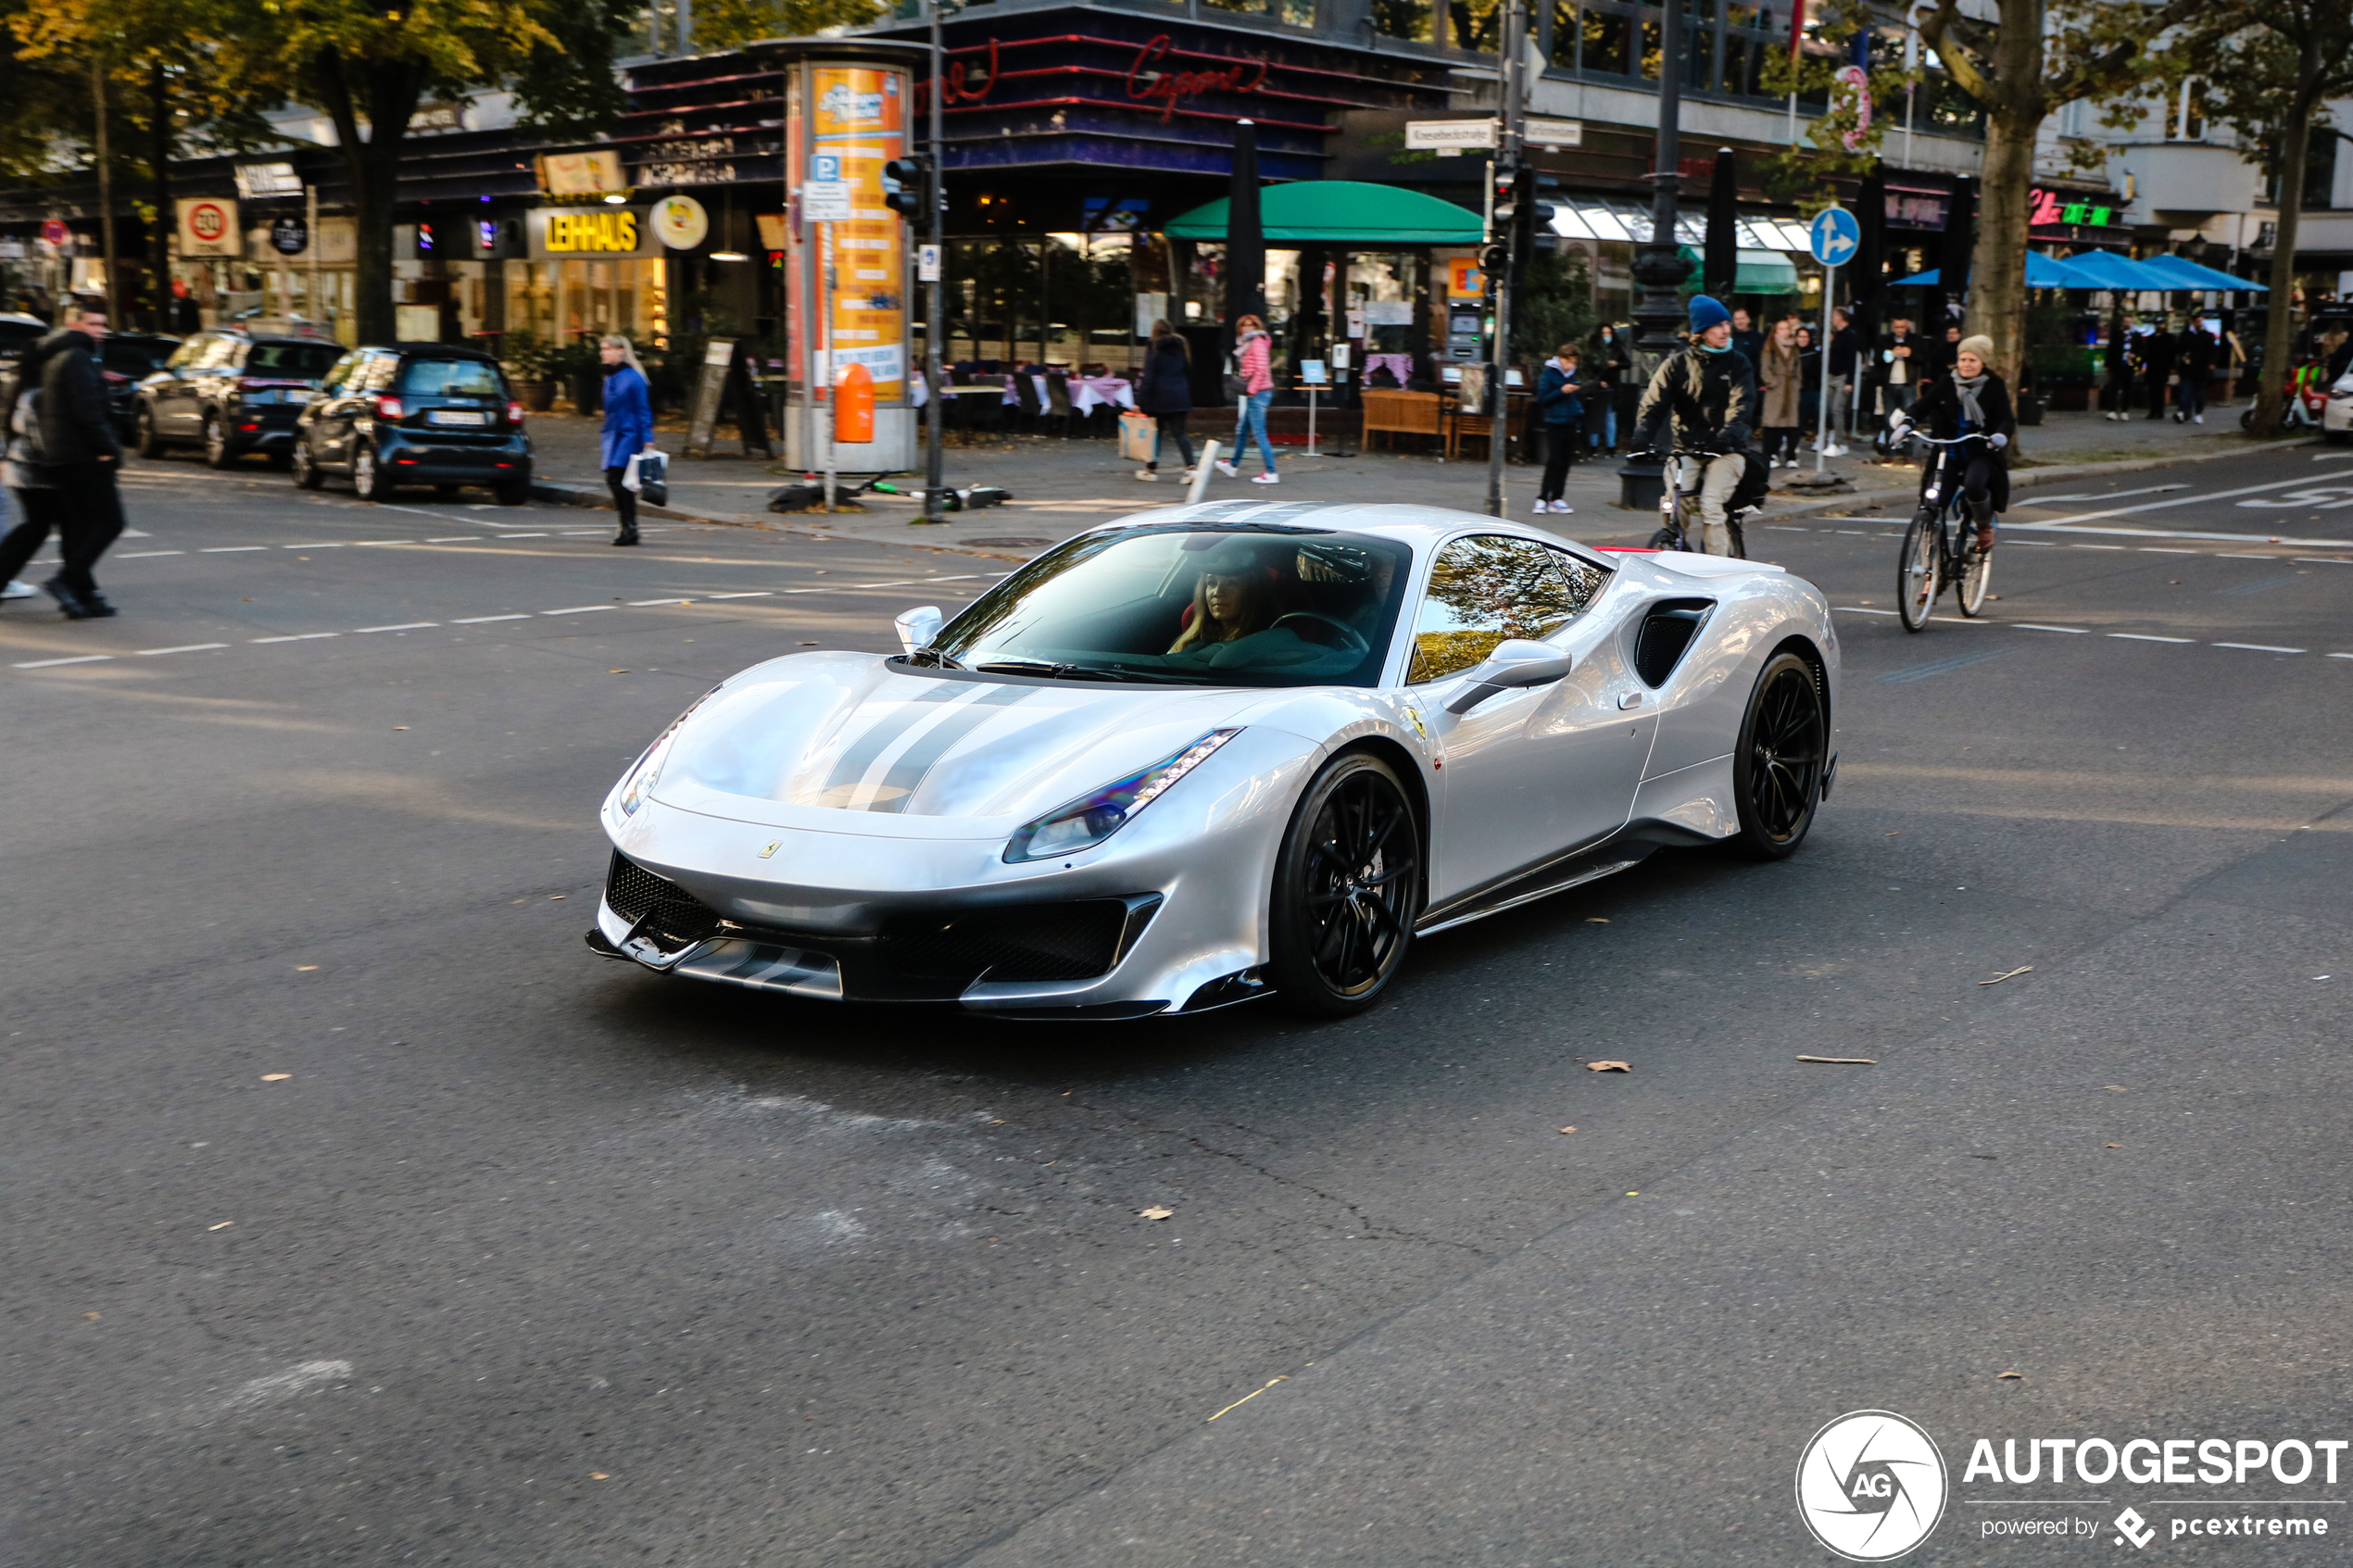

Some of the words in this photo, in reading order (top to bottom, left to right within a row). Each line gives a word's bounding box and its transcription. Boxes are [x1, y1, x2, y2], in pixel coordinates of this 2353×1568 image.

[1126, 34, 1269, 124] Capone
[195, 212, 220, 231] 30
[545, 210, 637, 252] LEIHHAUS
